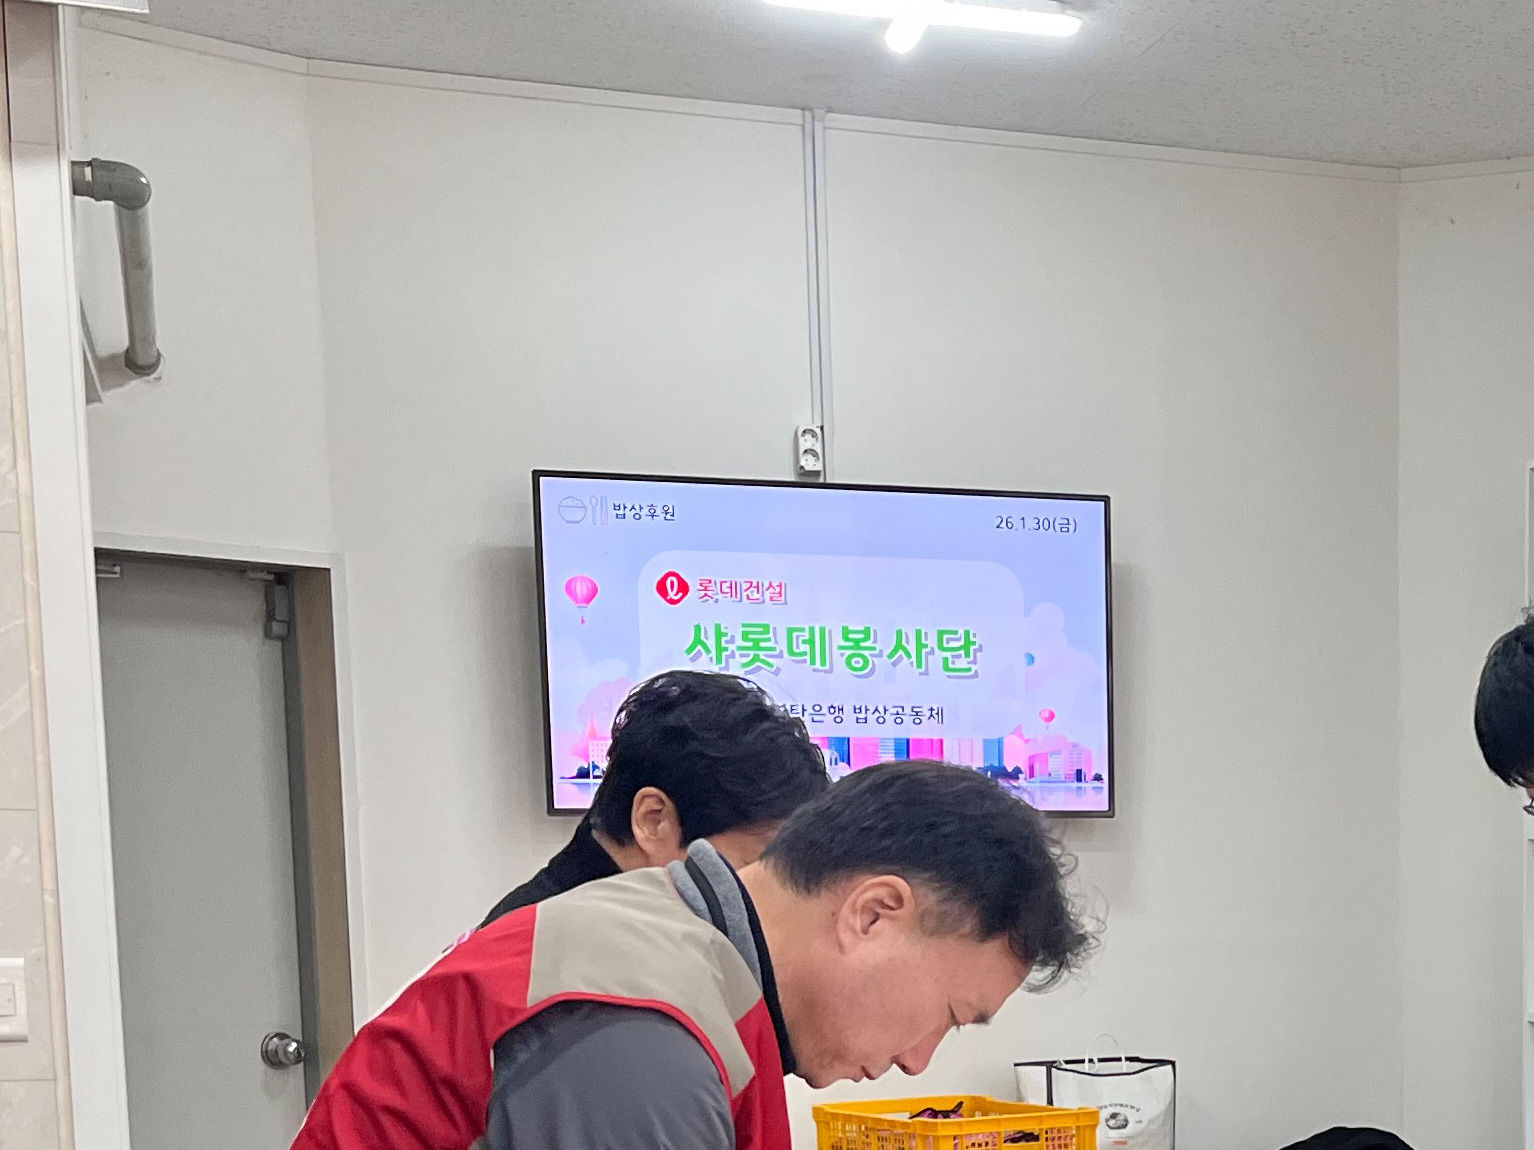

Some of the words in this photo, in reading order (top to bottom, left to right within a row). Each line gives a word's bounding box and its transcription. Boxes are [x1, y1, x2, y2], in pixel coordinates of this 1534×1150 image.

[612, 502, 677, 522] 밥상후원
[696, 578, 787, 603] 롯데건설
[684, 621, 982, 676] 샤롯데봉사단
[853, 704, 944, 725] 밥상공동체
